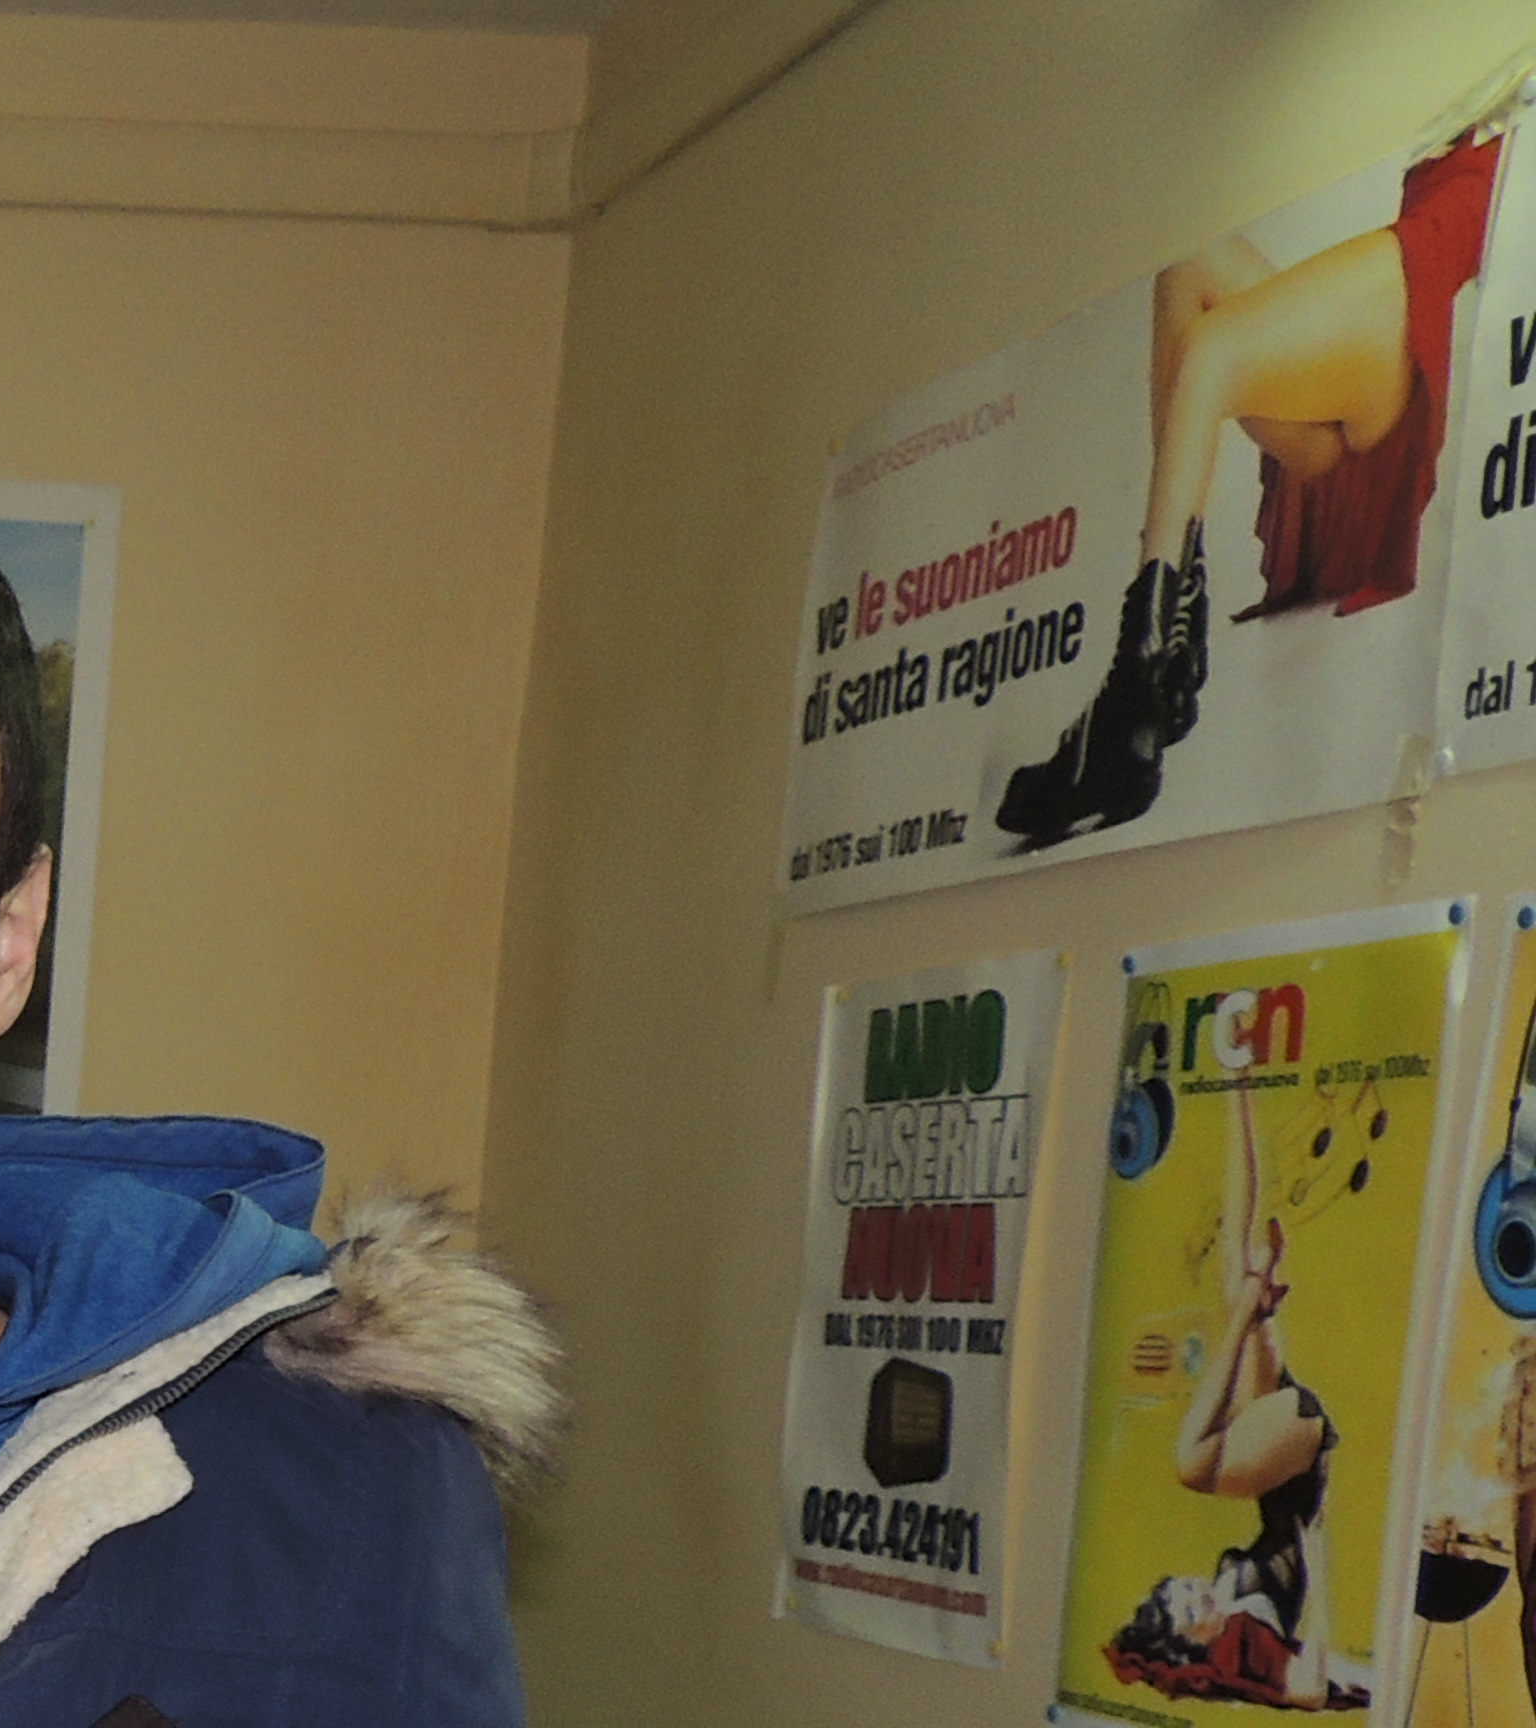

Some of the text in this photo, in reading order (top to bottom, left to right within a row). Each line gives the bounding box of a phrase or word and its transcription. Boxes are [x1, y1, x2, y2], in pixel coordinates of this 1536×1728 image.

[817, 506, 1076, 655] ve le suoniamo
[802, 602, 1085, 745] di santa ragione
[1465, 661, 1515, 721] dal
[889, 816, 923, 858] 100
[864, 989, 1006, 1104] RADIO
[1182, 983, 1305, 1071] rcn
[833, 1094, 1030, 1206] CASERTA
[841, 1203, 995, 1304] NUOVA
[826, 1313, 852, 1347] DAL
[857, 1314, 895, 1350] 1976
[927, 1316, 962, 1353] 100
[966, 1318, 1006, 1355] MHZ
[801, 1486, 982, 1576] 0823.424191
